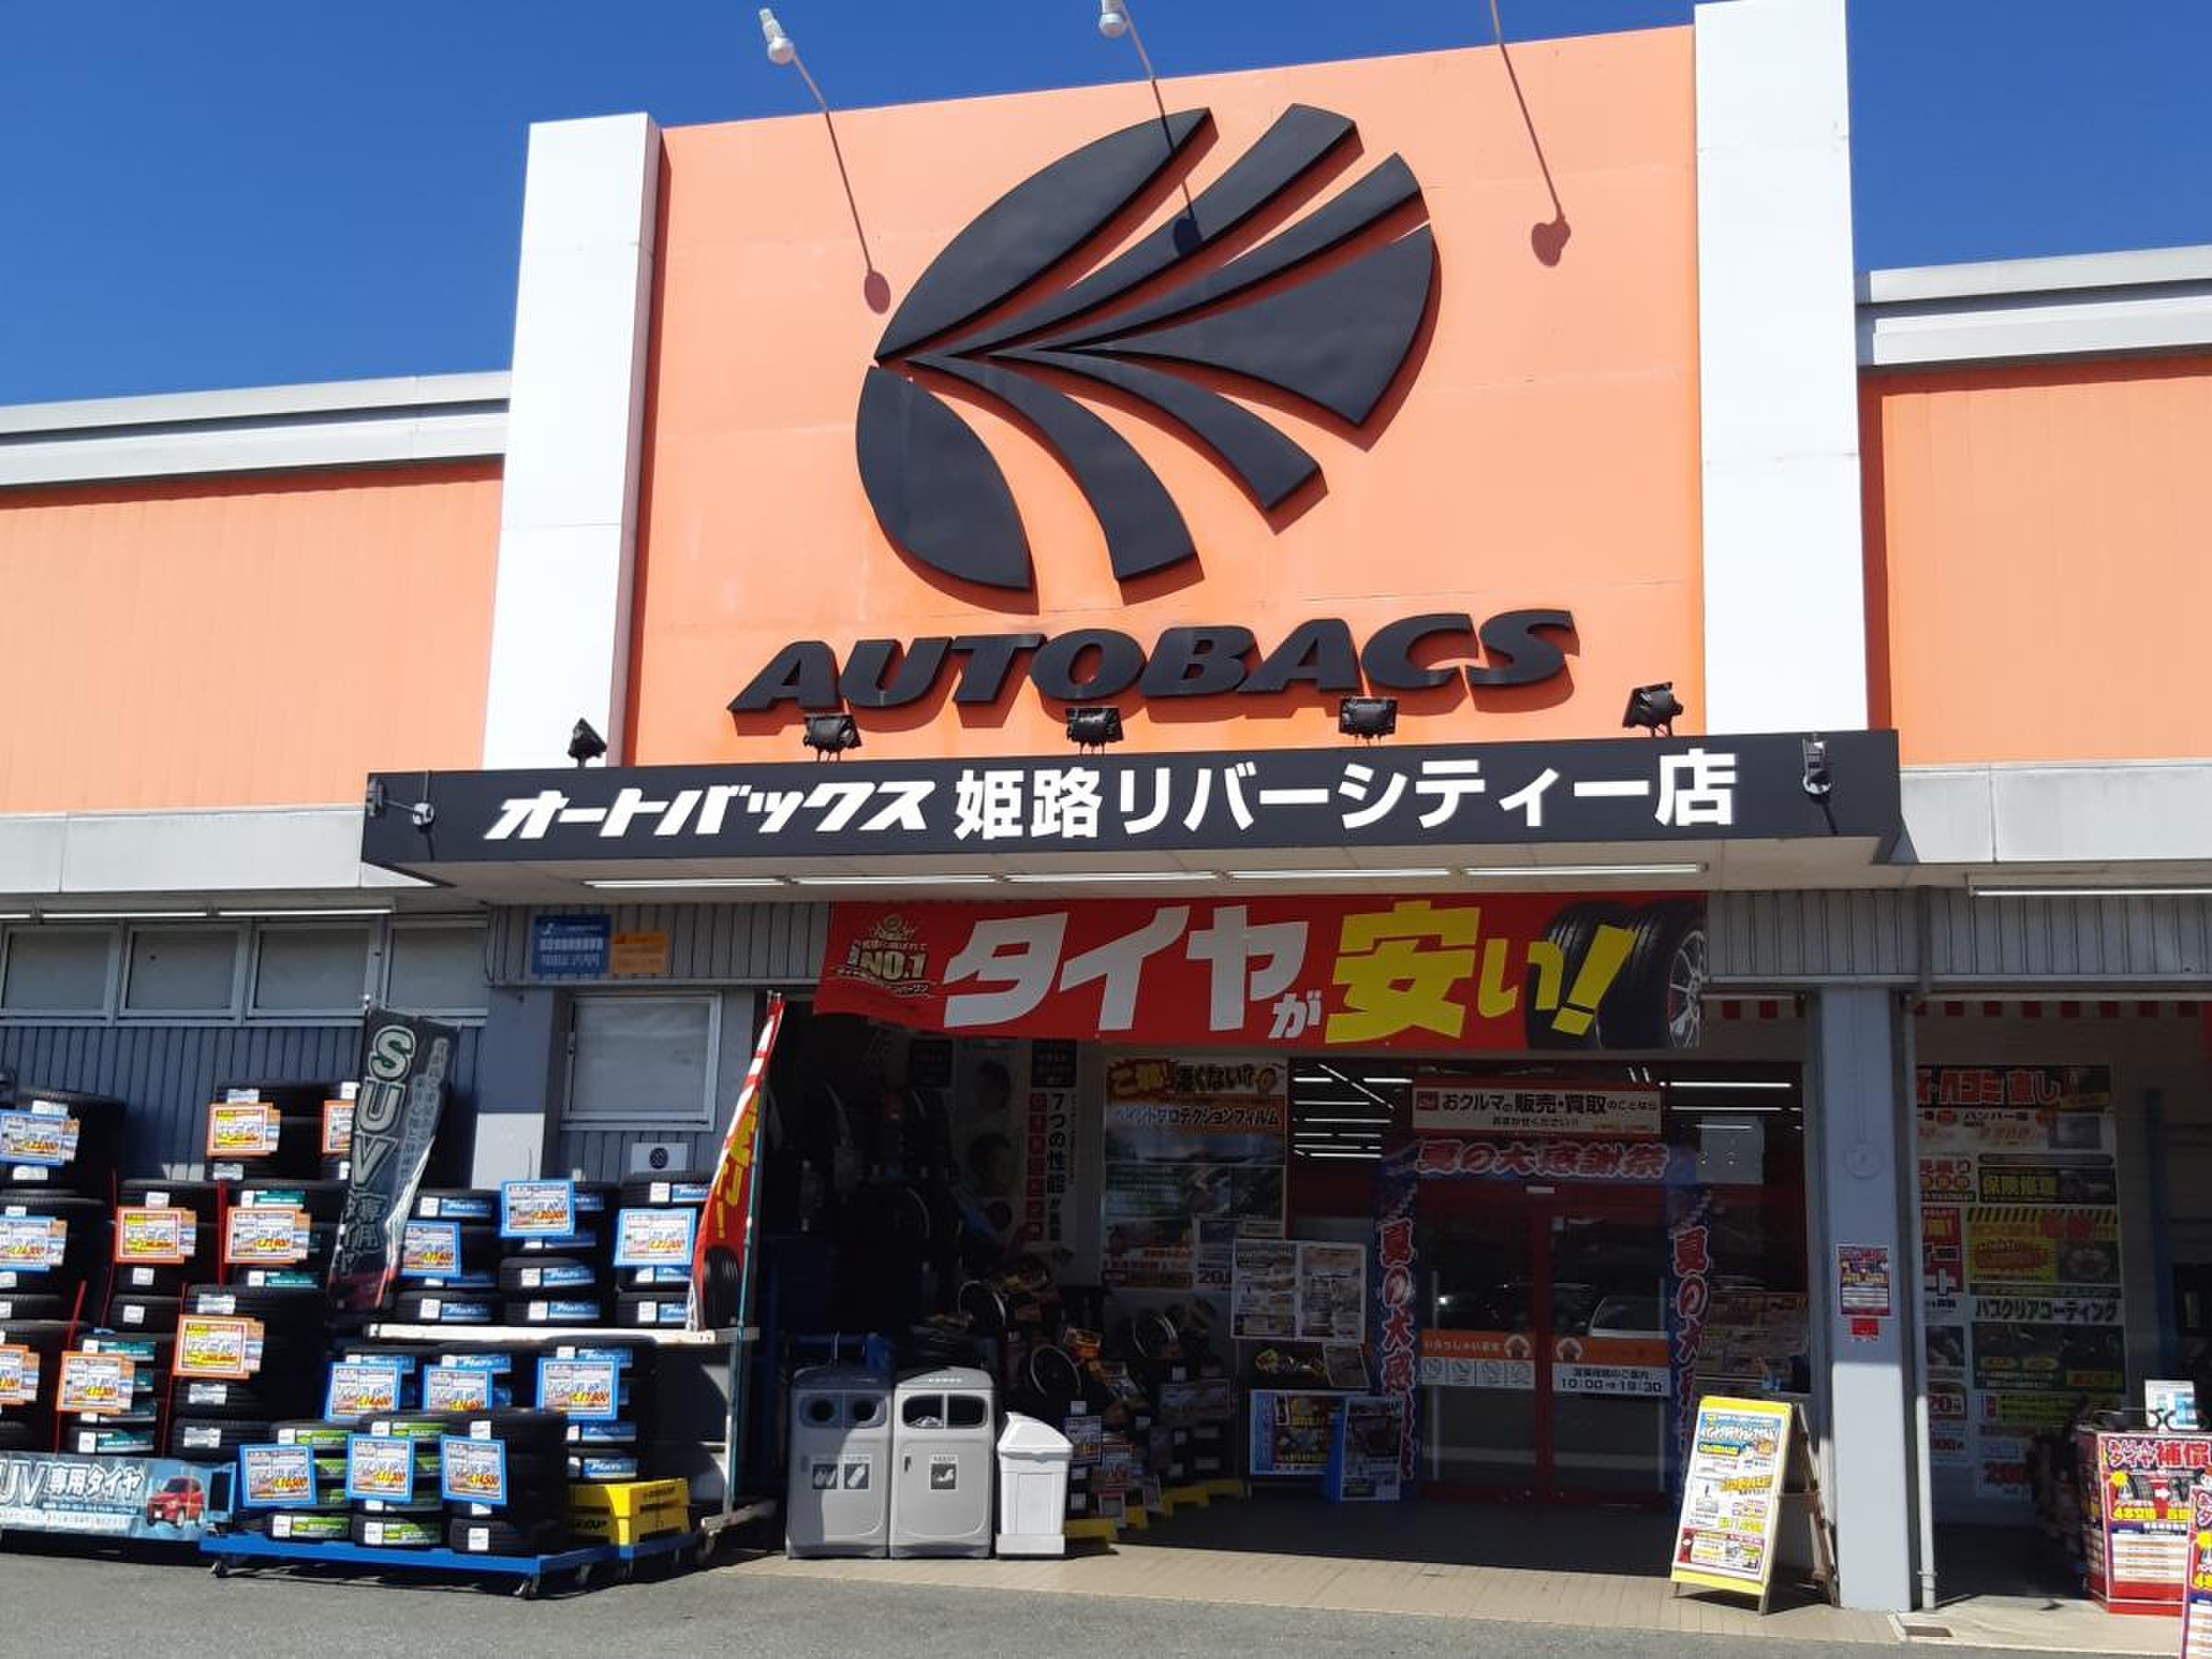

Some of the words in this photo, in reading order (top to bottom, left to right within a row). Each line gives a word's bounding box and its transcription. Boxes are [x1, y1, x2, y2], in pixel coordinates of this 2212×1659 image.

[728, 608, 1573, 712] AUTOBACS
[483, 780, 936, 841] オートバックス
[952, 747, 1738, 841] 姫路リバーシティー店
